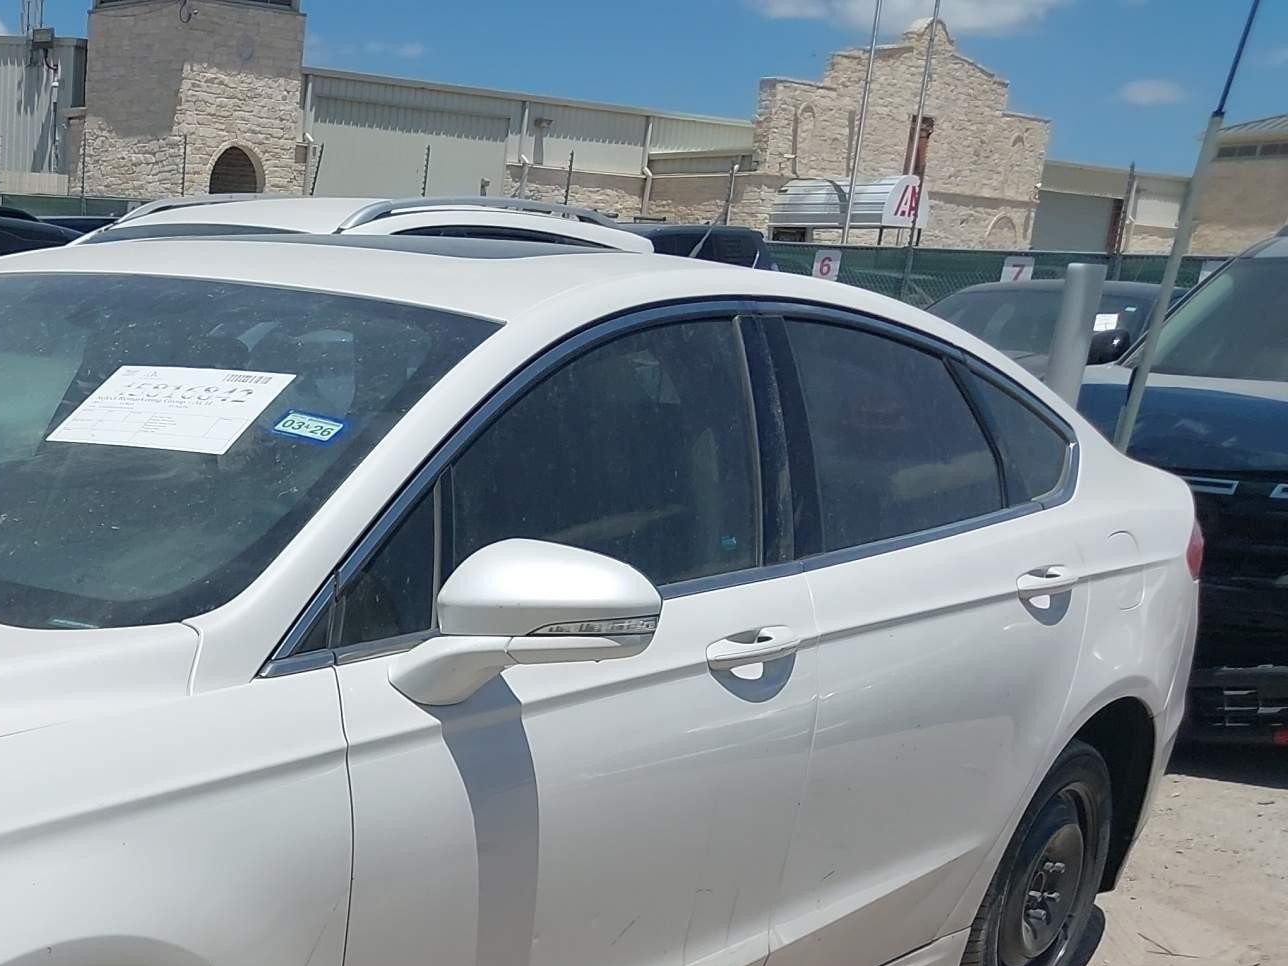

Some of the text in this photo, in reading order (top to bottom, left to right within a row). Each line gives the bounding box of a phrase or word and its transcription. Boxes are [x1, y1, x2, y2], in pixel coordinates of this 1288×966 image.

[819, 256, 833, 276] 6
[1012, 263, 1025, 281] 7
[282, 419, 334, 437] 03 26
